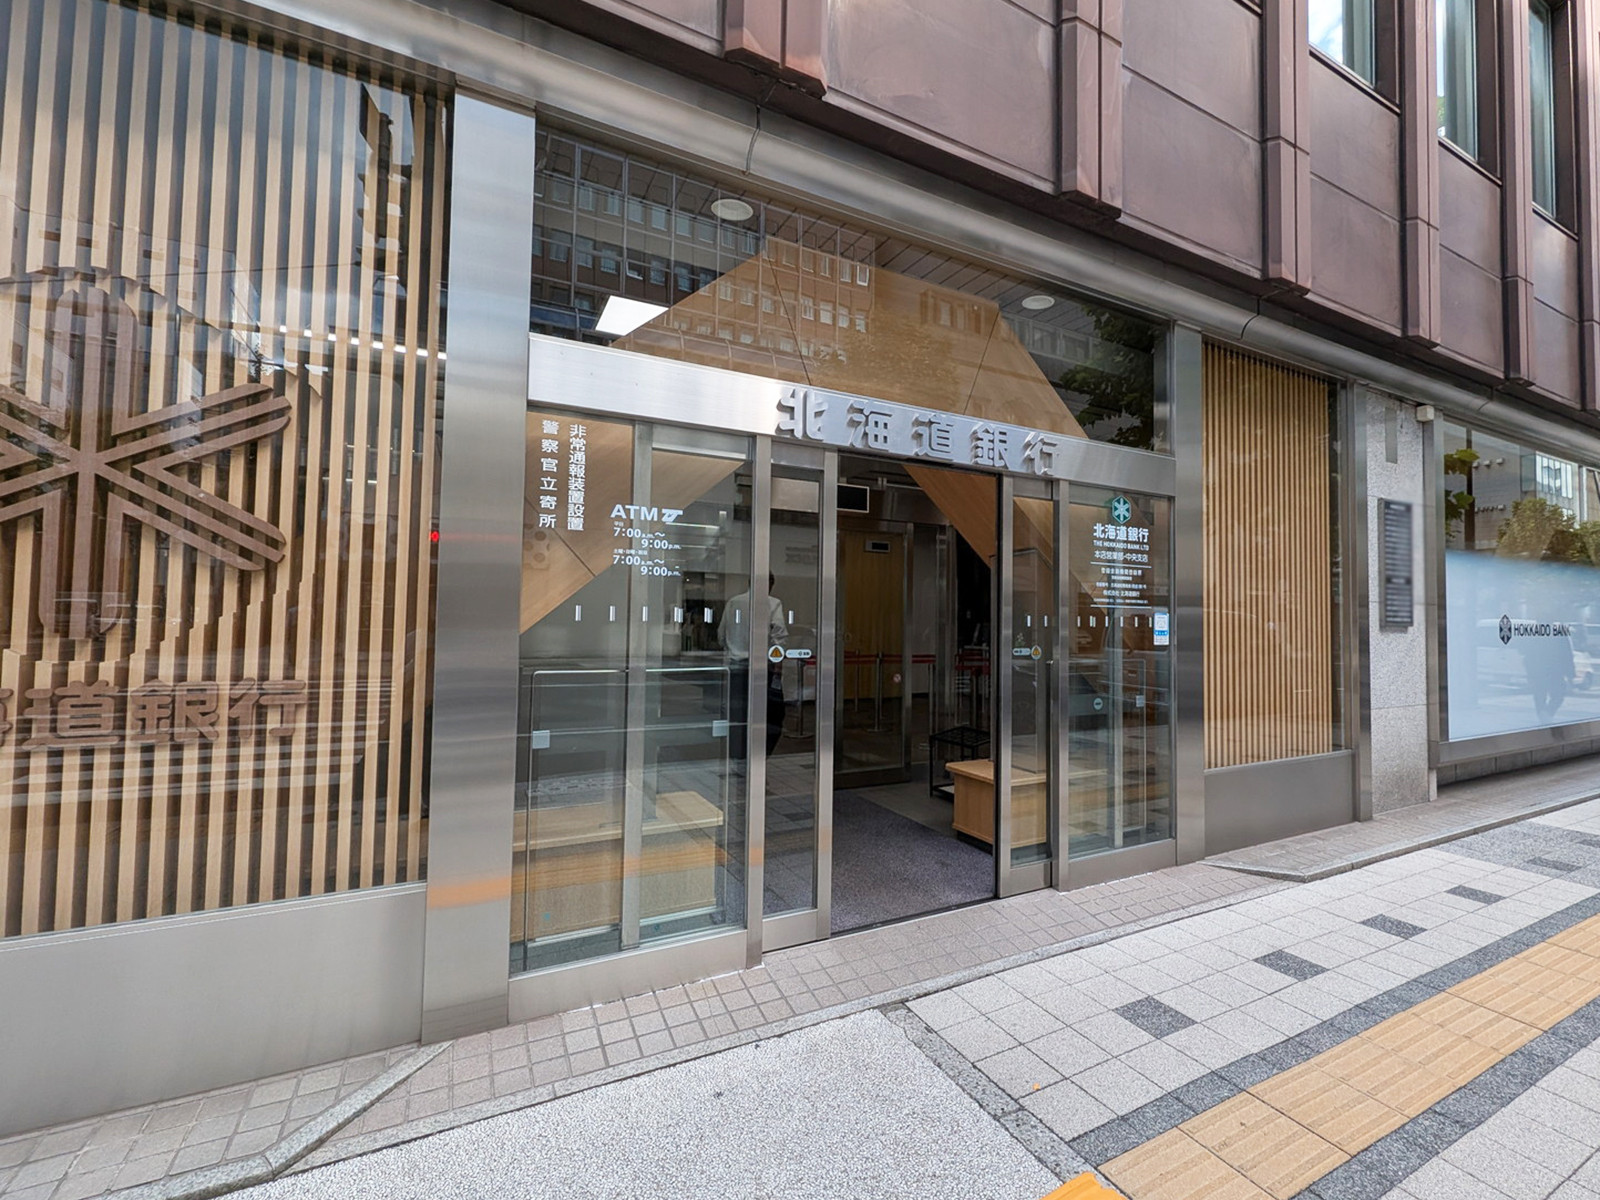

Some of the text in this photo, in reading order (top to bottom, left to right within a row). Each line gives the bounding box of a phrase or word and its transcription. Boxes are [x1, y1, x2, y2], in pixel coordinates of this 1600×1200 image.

[775, 388, 1058, 475] 北海道銀行
[538, 419, 560, 529] 警察官立寄所
[567, 424, 587, 531] 非常通報装置設置
[610, 504, 658, 521] ATM
[1093, 522, 1149, 543] 北海道銀行
[1513, 623, 1571, 637] HOKKAIDO BANK
[0, 677, 308, 751] 道銀行
